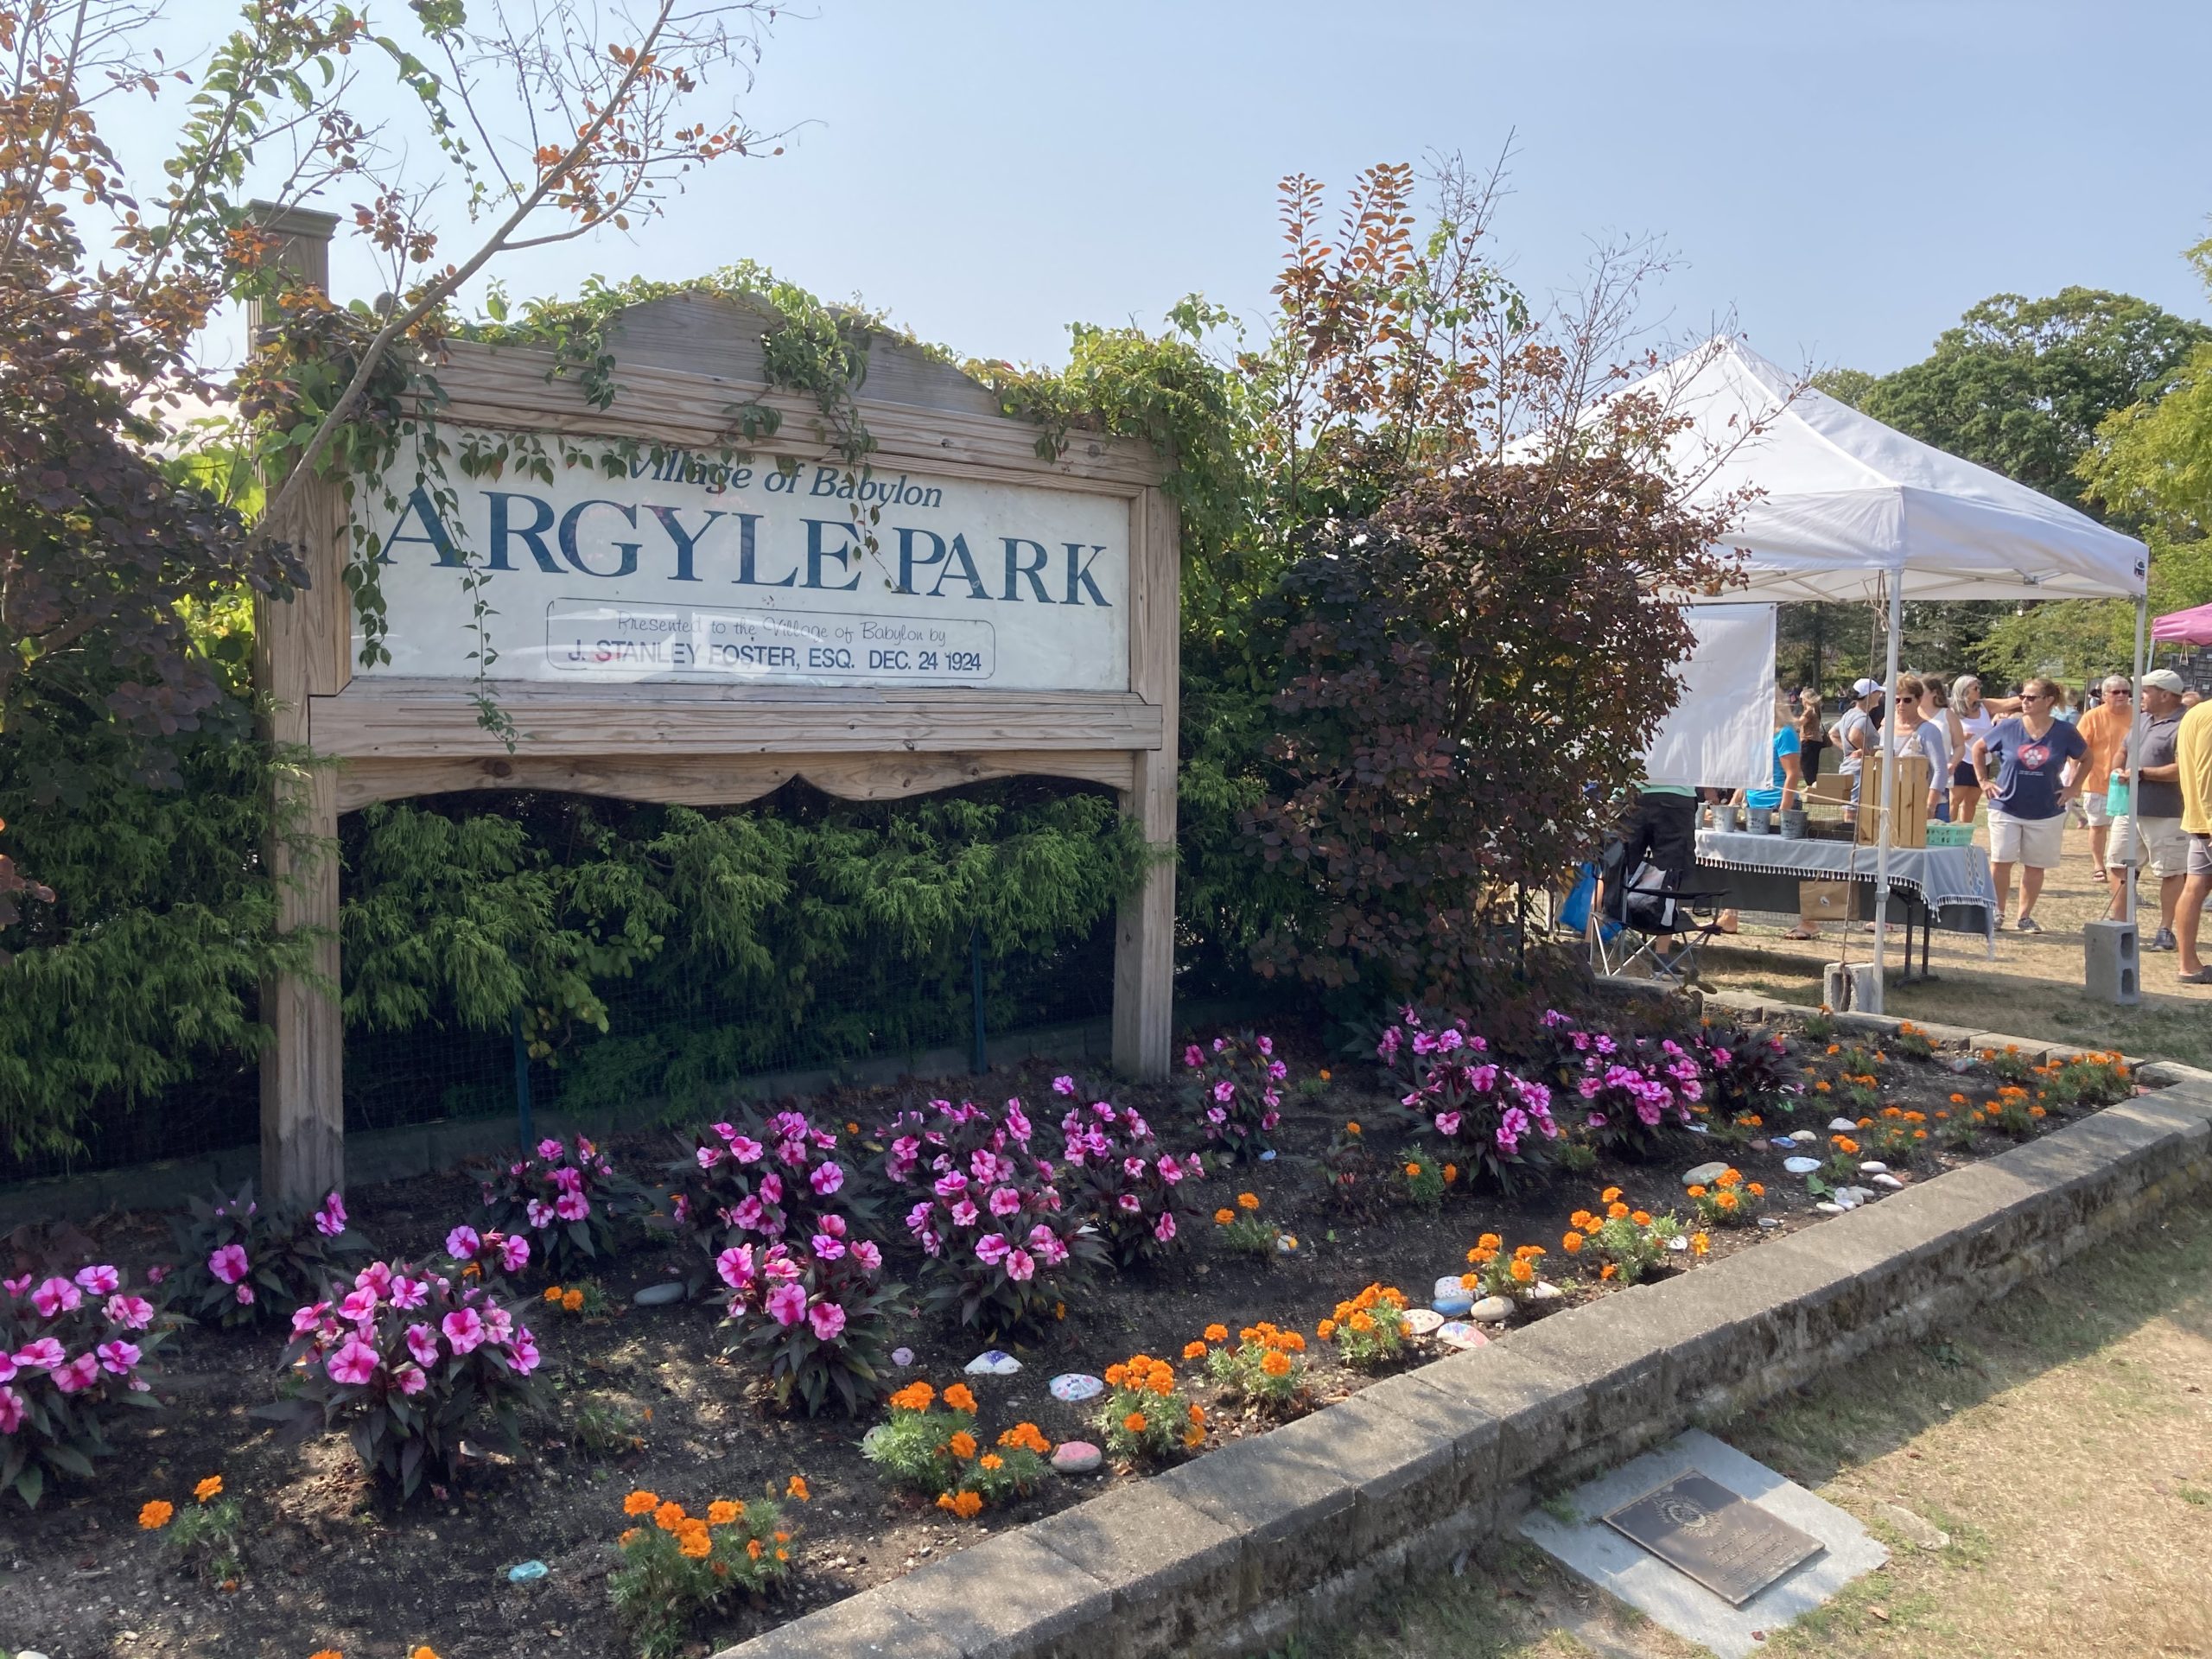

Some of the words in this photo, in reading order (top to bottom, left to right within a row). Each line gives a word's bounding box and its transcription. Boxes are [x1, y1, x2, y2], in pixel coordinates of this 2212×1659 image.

[765, 463, 805, 494] of
[809, 467, 943, 508] Babylon
[375, 485, 862, 590] ARGYLE
[891, 526, 1113, 607] PARK
[618, 610, 702, 634] Presented
[711, 619, 726, 634] to
[734, 616, 757, 636] the
[763, 616, 828, 643] Village
[835, 626, 854, 644] of
[860, 621, 923, 645] Babylon
[930, 627, 946, 647] by
[568, 639, 586, 662] J.
[595, 639, 701, 664] STANLEY
[709, 644, 800, 671] FOSTER,
[809, 647, 855, 669] ESQ.
[869, 650, 912, 670] DEC.
[918, 651, 938, 671] 24
[944, 652, 982, 671] 1924
